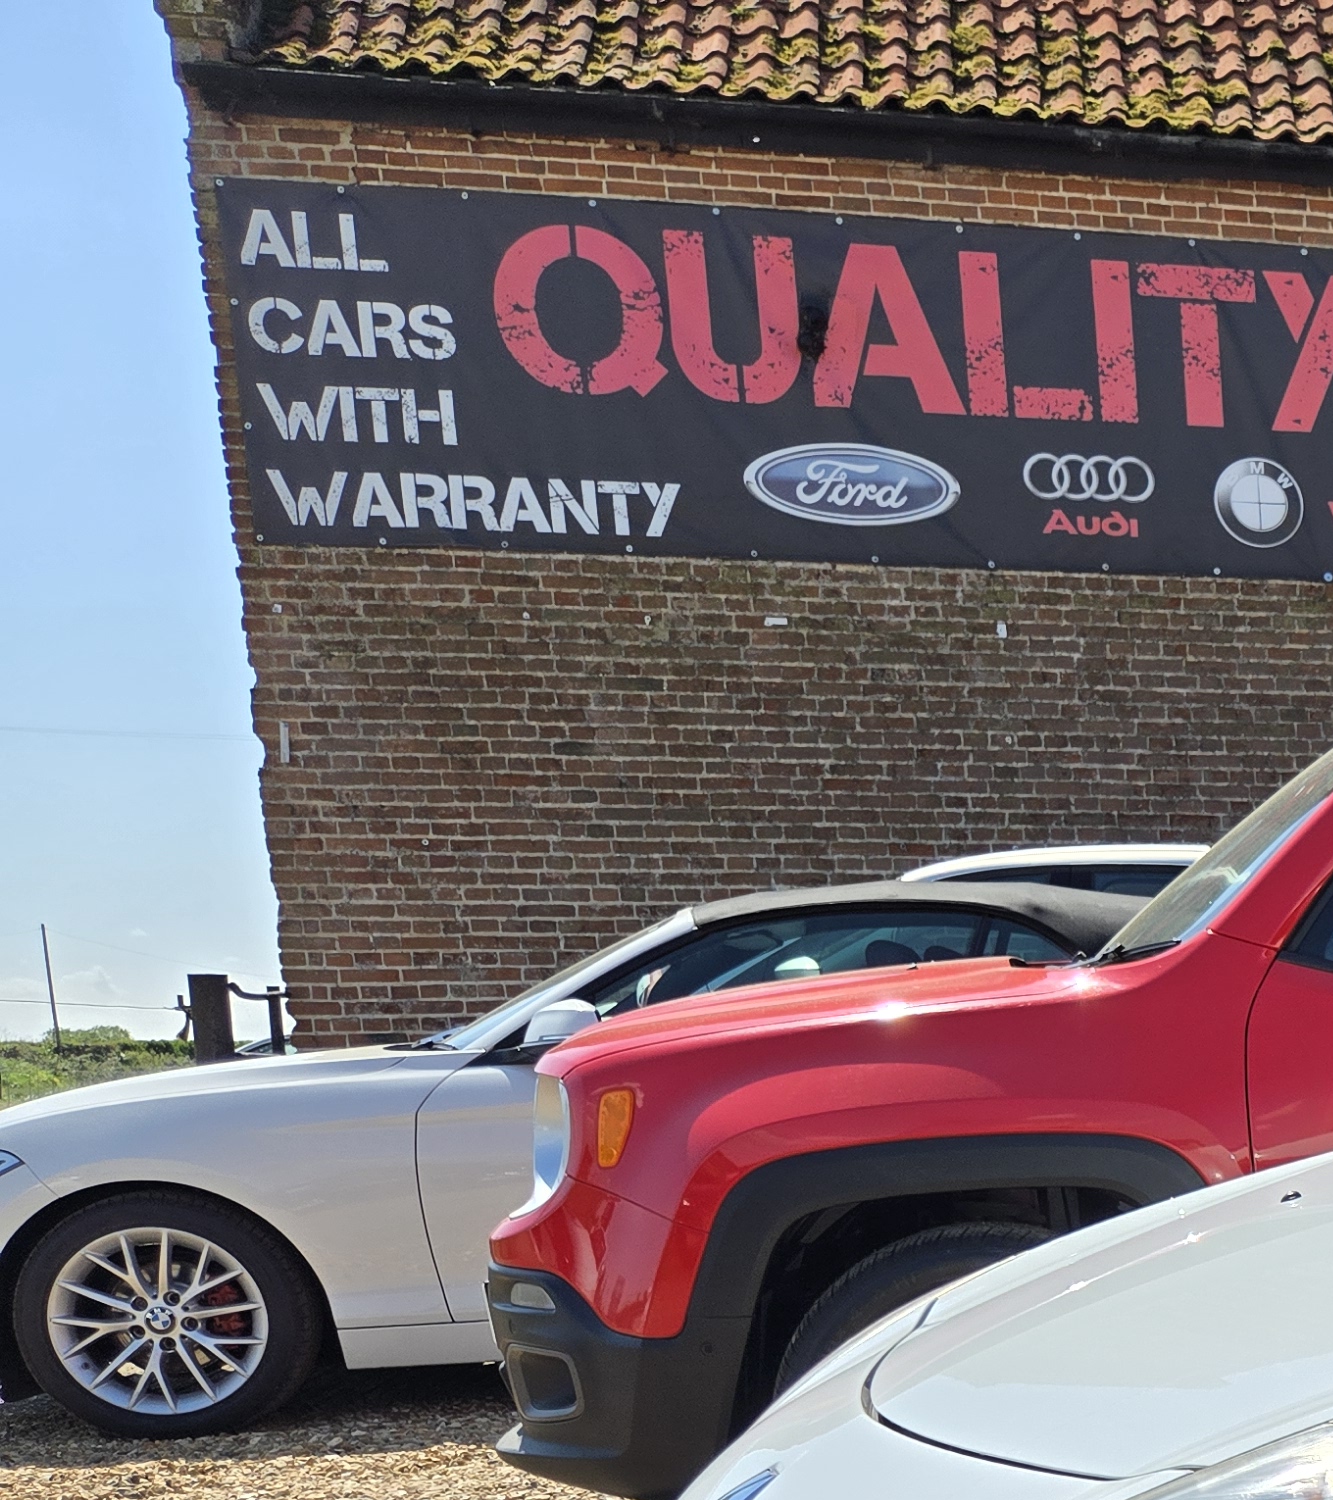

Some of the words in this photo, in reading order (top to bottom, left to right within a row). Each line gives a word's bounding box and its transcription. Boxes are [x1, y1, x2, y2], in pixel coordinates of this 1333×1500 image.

[240, 208, 389, 273] ALL
[247, 296, 458, 361] CARS
[255, 382, 459, 446] WITH
[265, 468, 681, 538] WARRANTY
[795, 459, 909, 509] Ford
[1043, 508, 1140, 538] Audi
